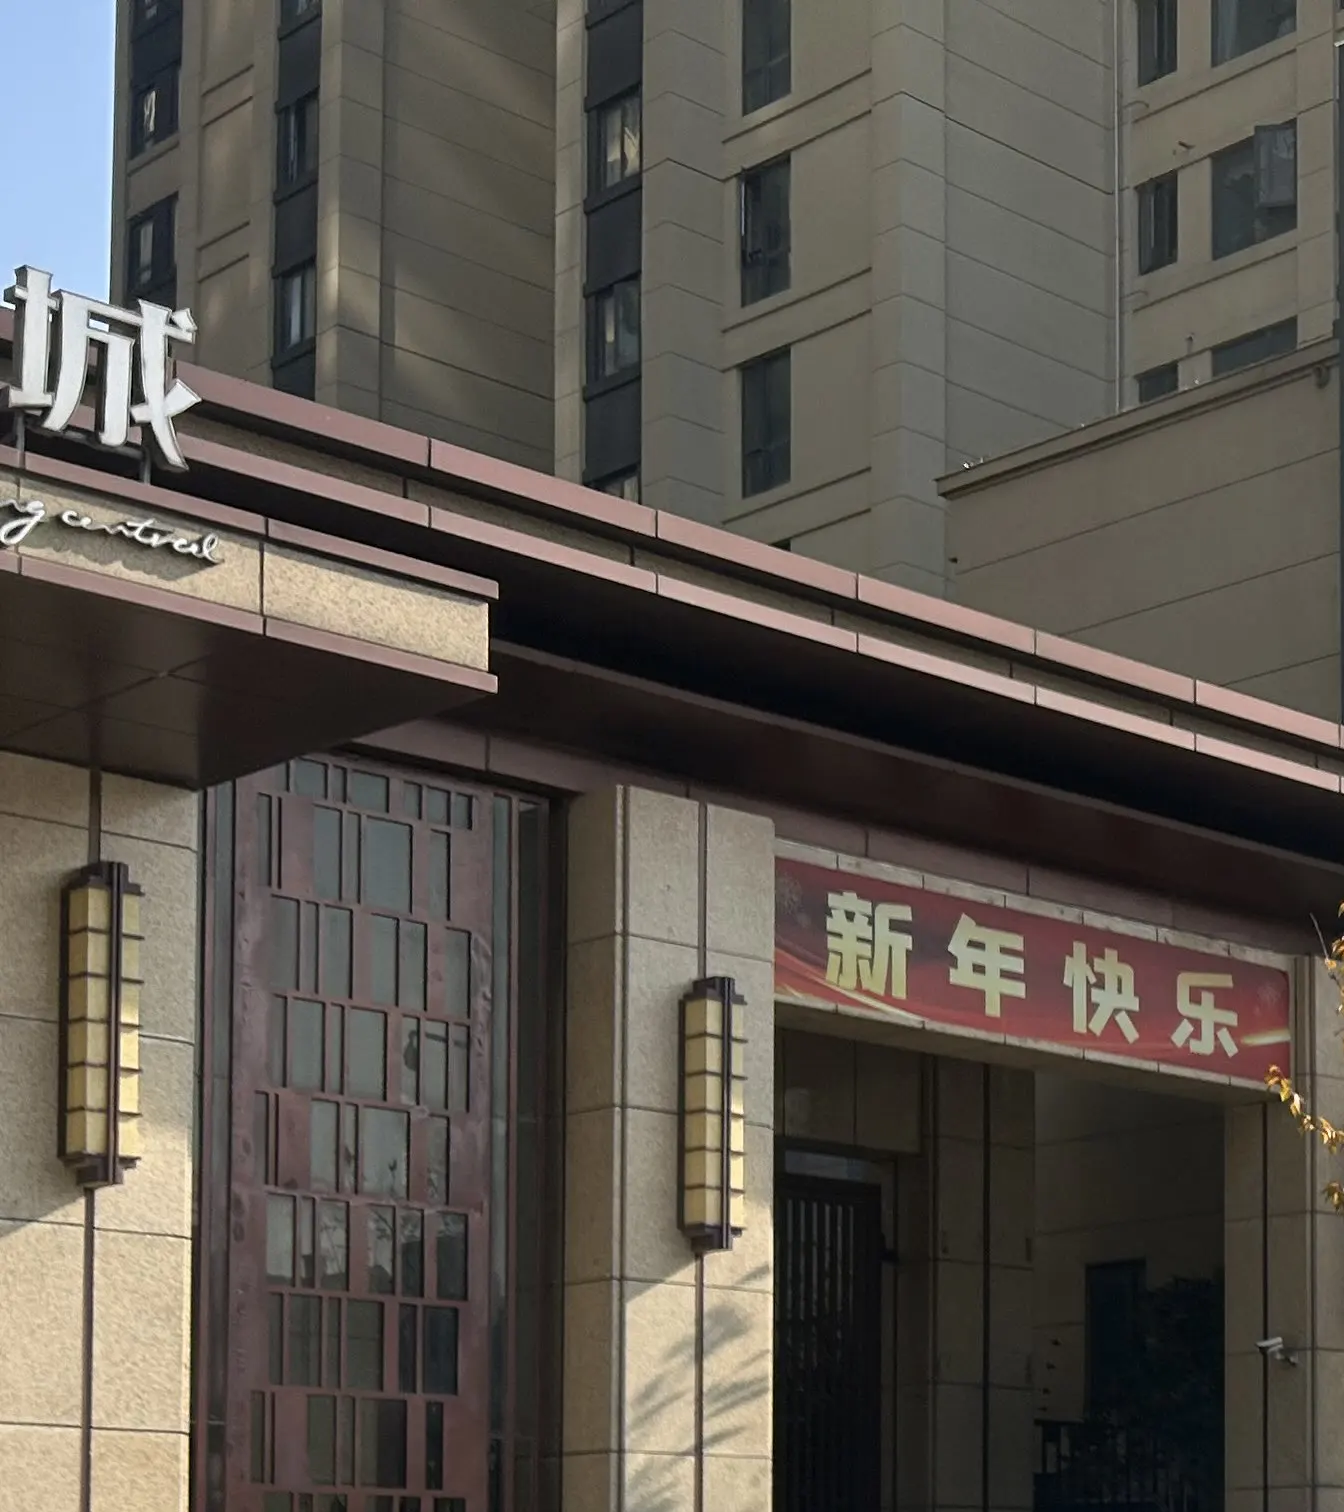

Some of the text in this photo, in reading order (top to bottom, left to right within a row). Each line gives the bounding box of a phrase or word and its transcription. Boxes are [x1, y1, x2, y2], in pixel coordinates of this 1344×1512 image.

[6, 264, 201, 471] 城
[61, 509, 222, 563] central
[825, 891, 1239, 1058] 新年快乐
